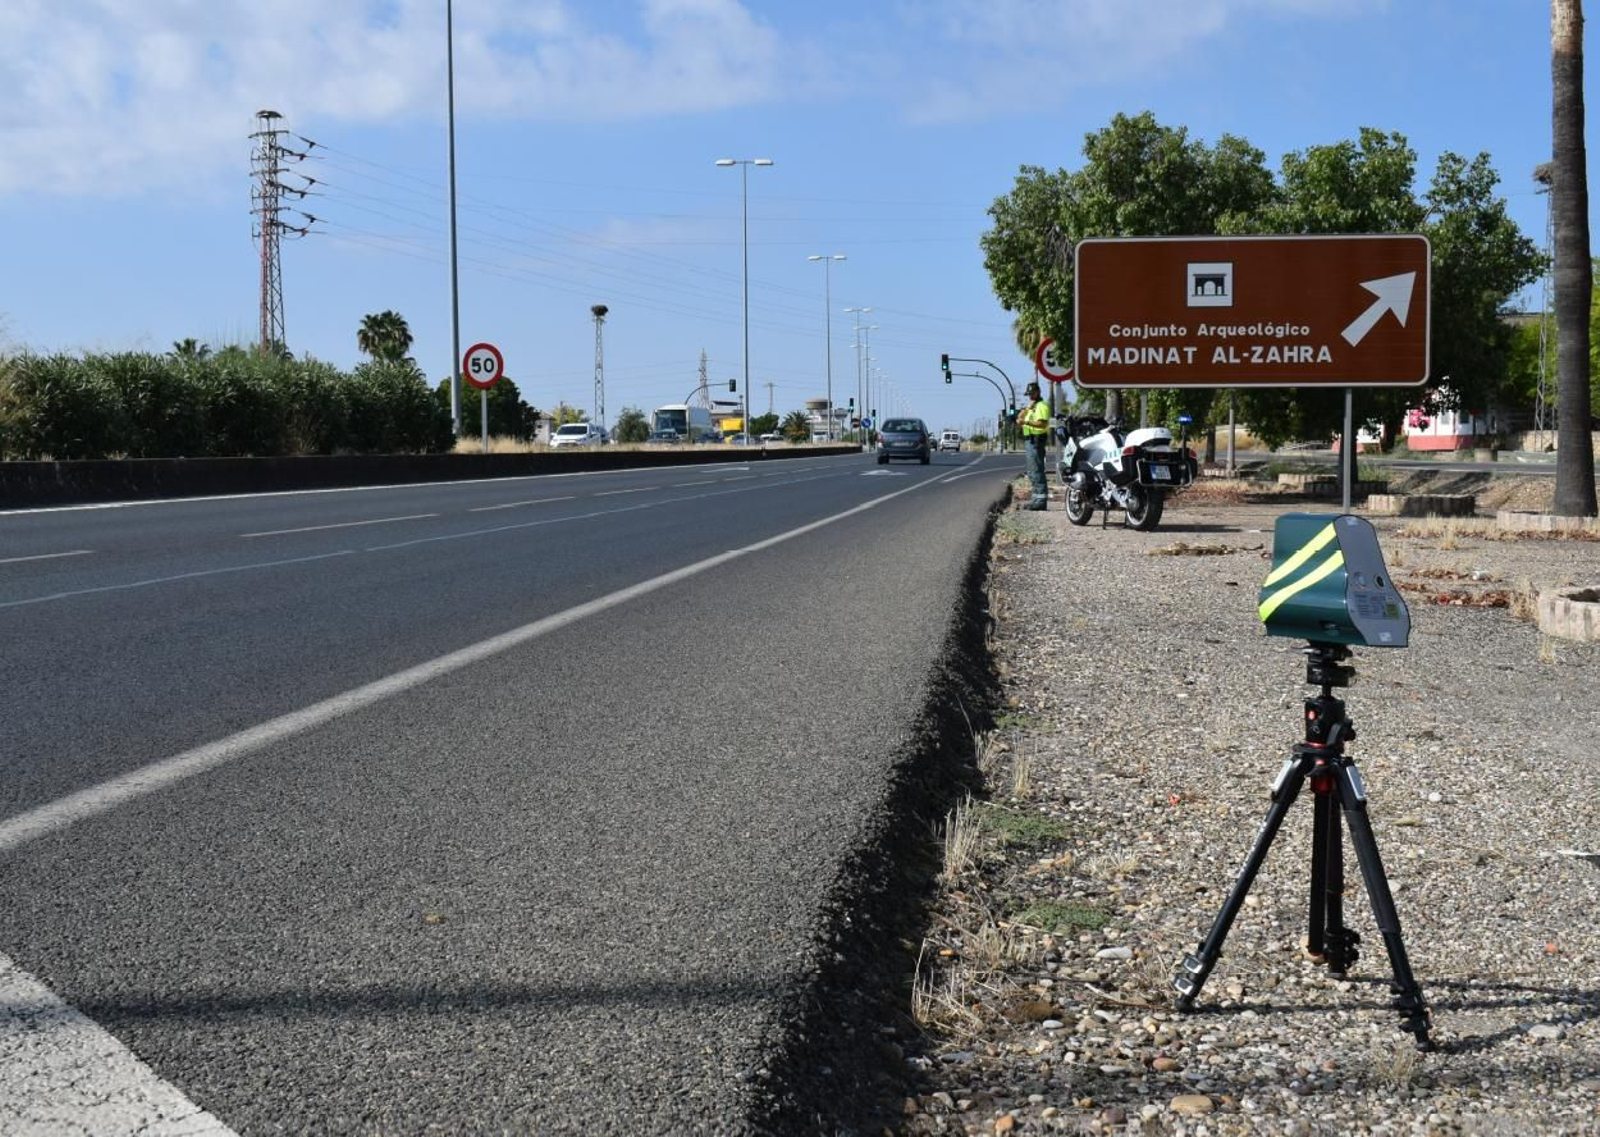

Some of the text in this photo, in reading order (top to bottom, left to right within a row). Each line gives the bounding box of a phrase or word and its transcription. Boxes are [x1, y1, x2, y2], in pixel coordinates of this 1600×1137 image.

[1109, 322, 1310, 338] Conjunto Arqueológico
[1087, 345, 1332, 365] MADINAT AL-ZAHRA
[471, 357, 494, 373] 50
